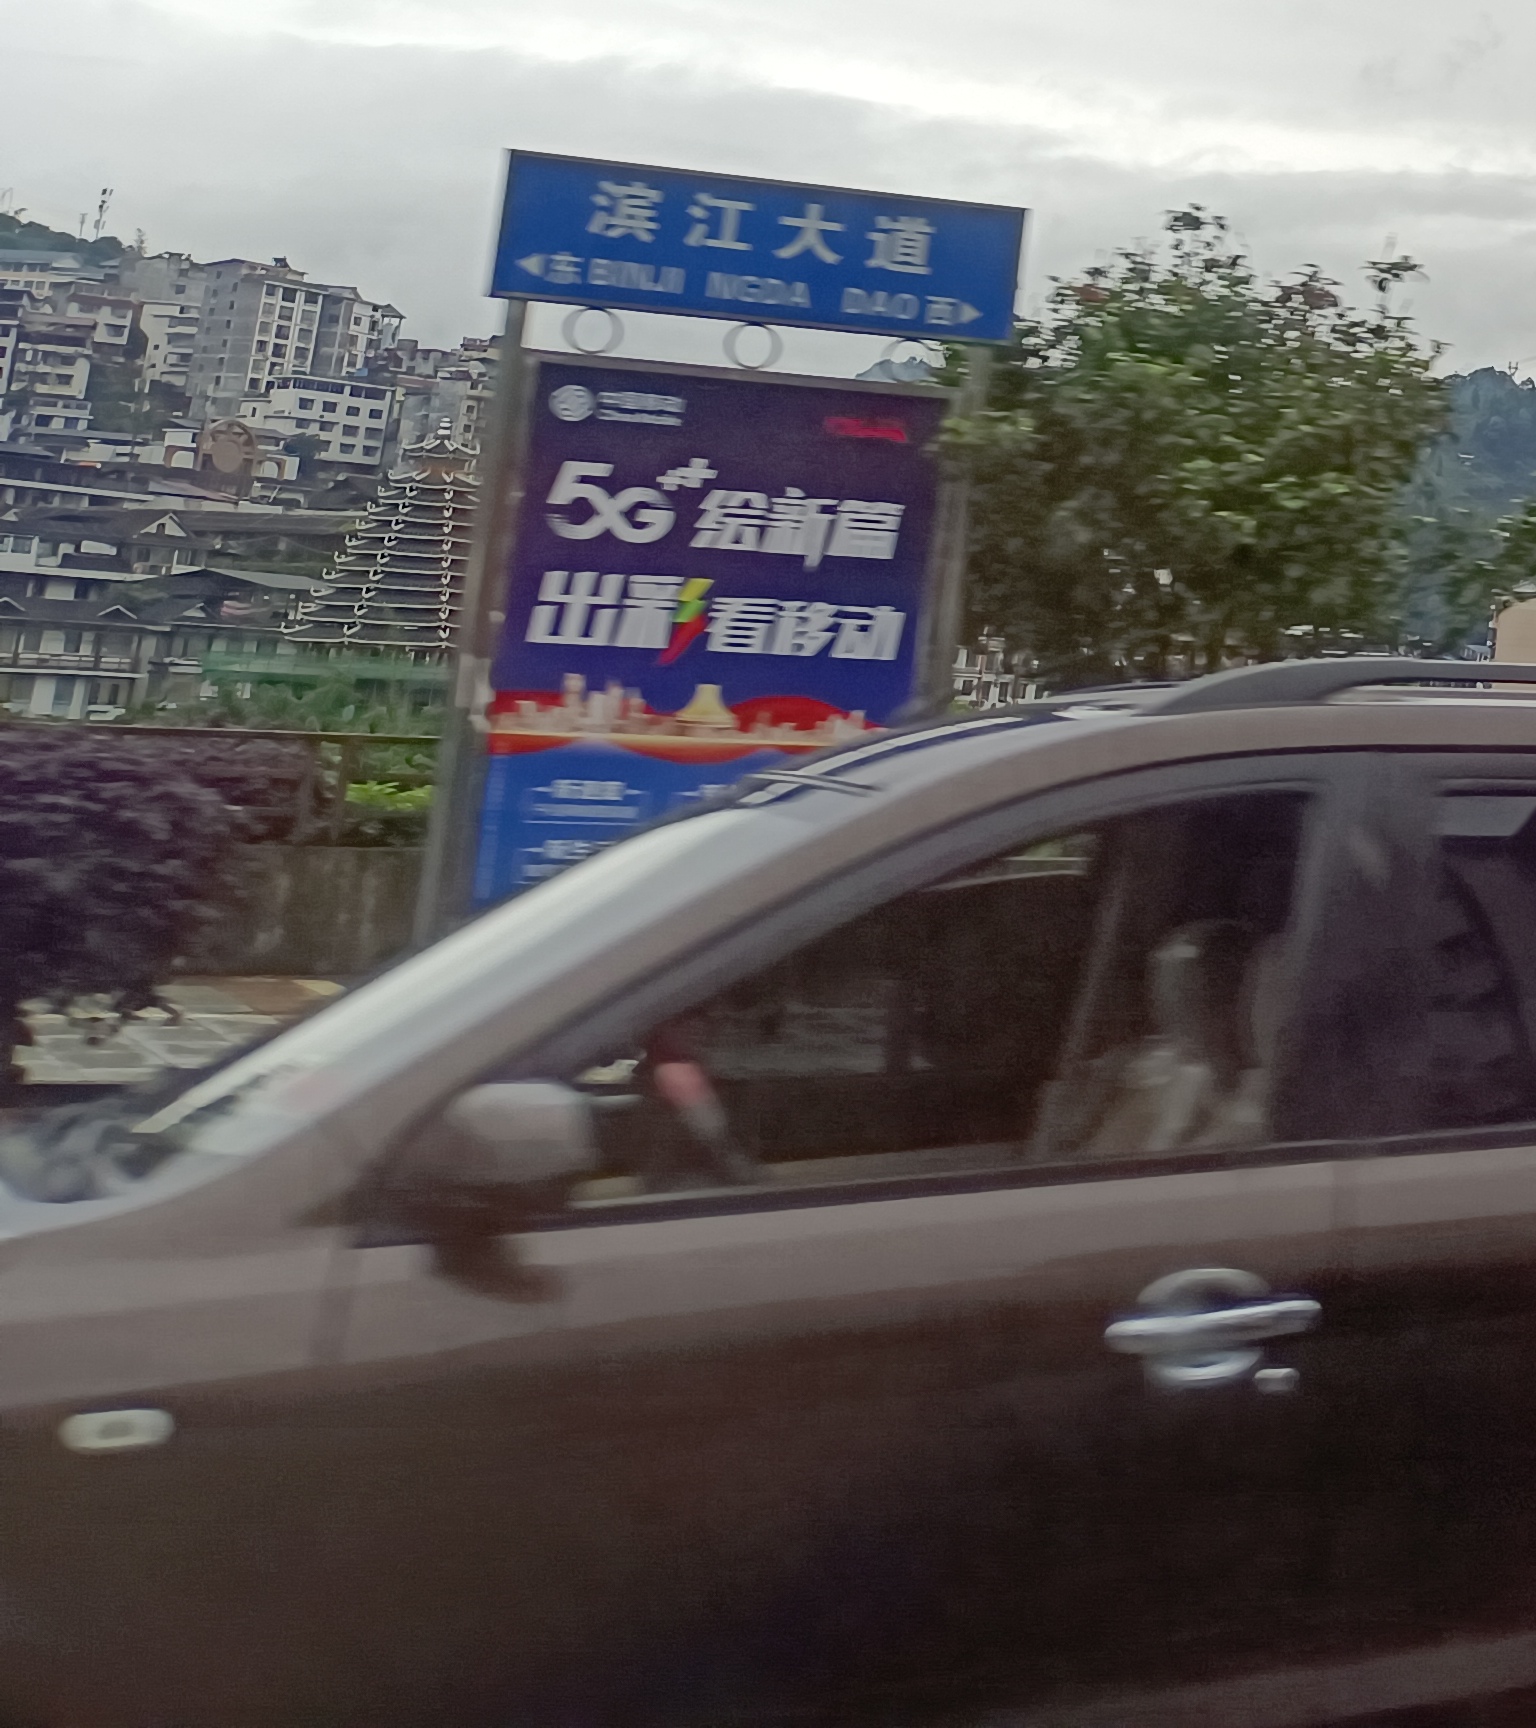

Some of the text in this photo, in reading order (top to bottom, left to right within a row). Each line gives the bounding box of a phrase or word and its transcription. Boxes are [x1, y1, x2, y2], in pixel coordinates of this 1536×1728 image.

[585, 180, 937, 276] 滨江大道
[924, 295, 959, 327] 西
[524, 570, 906, 664] 出彩看移动
